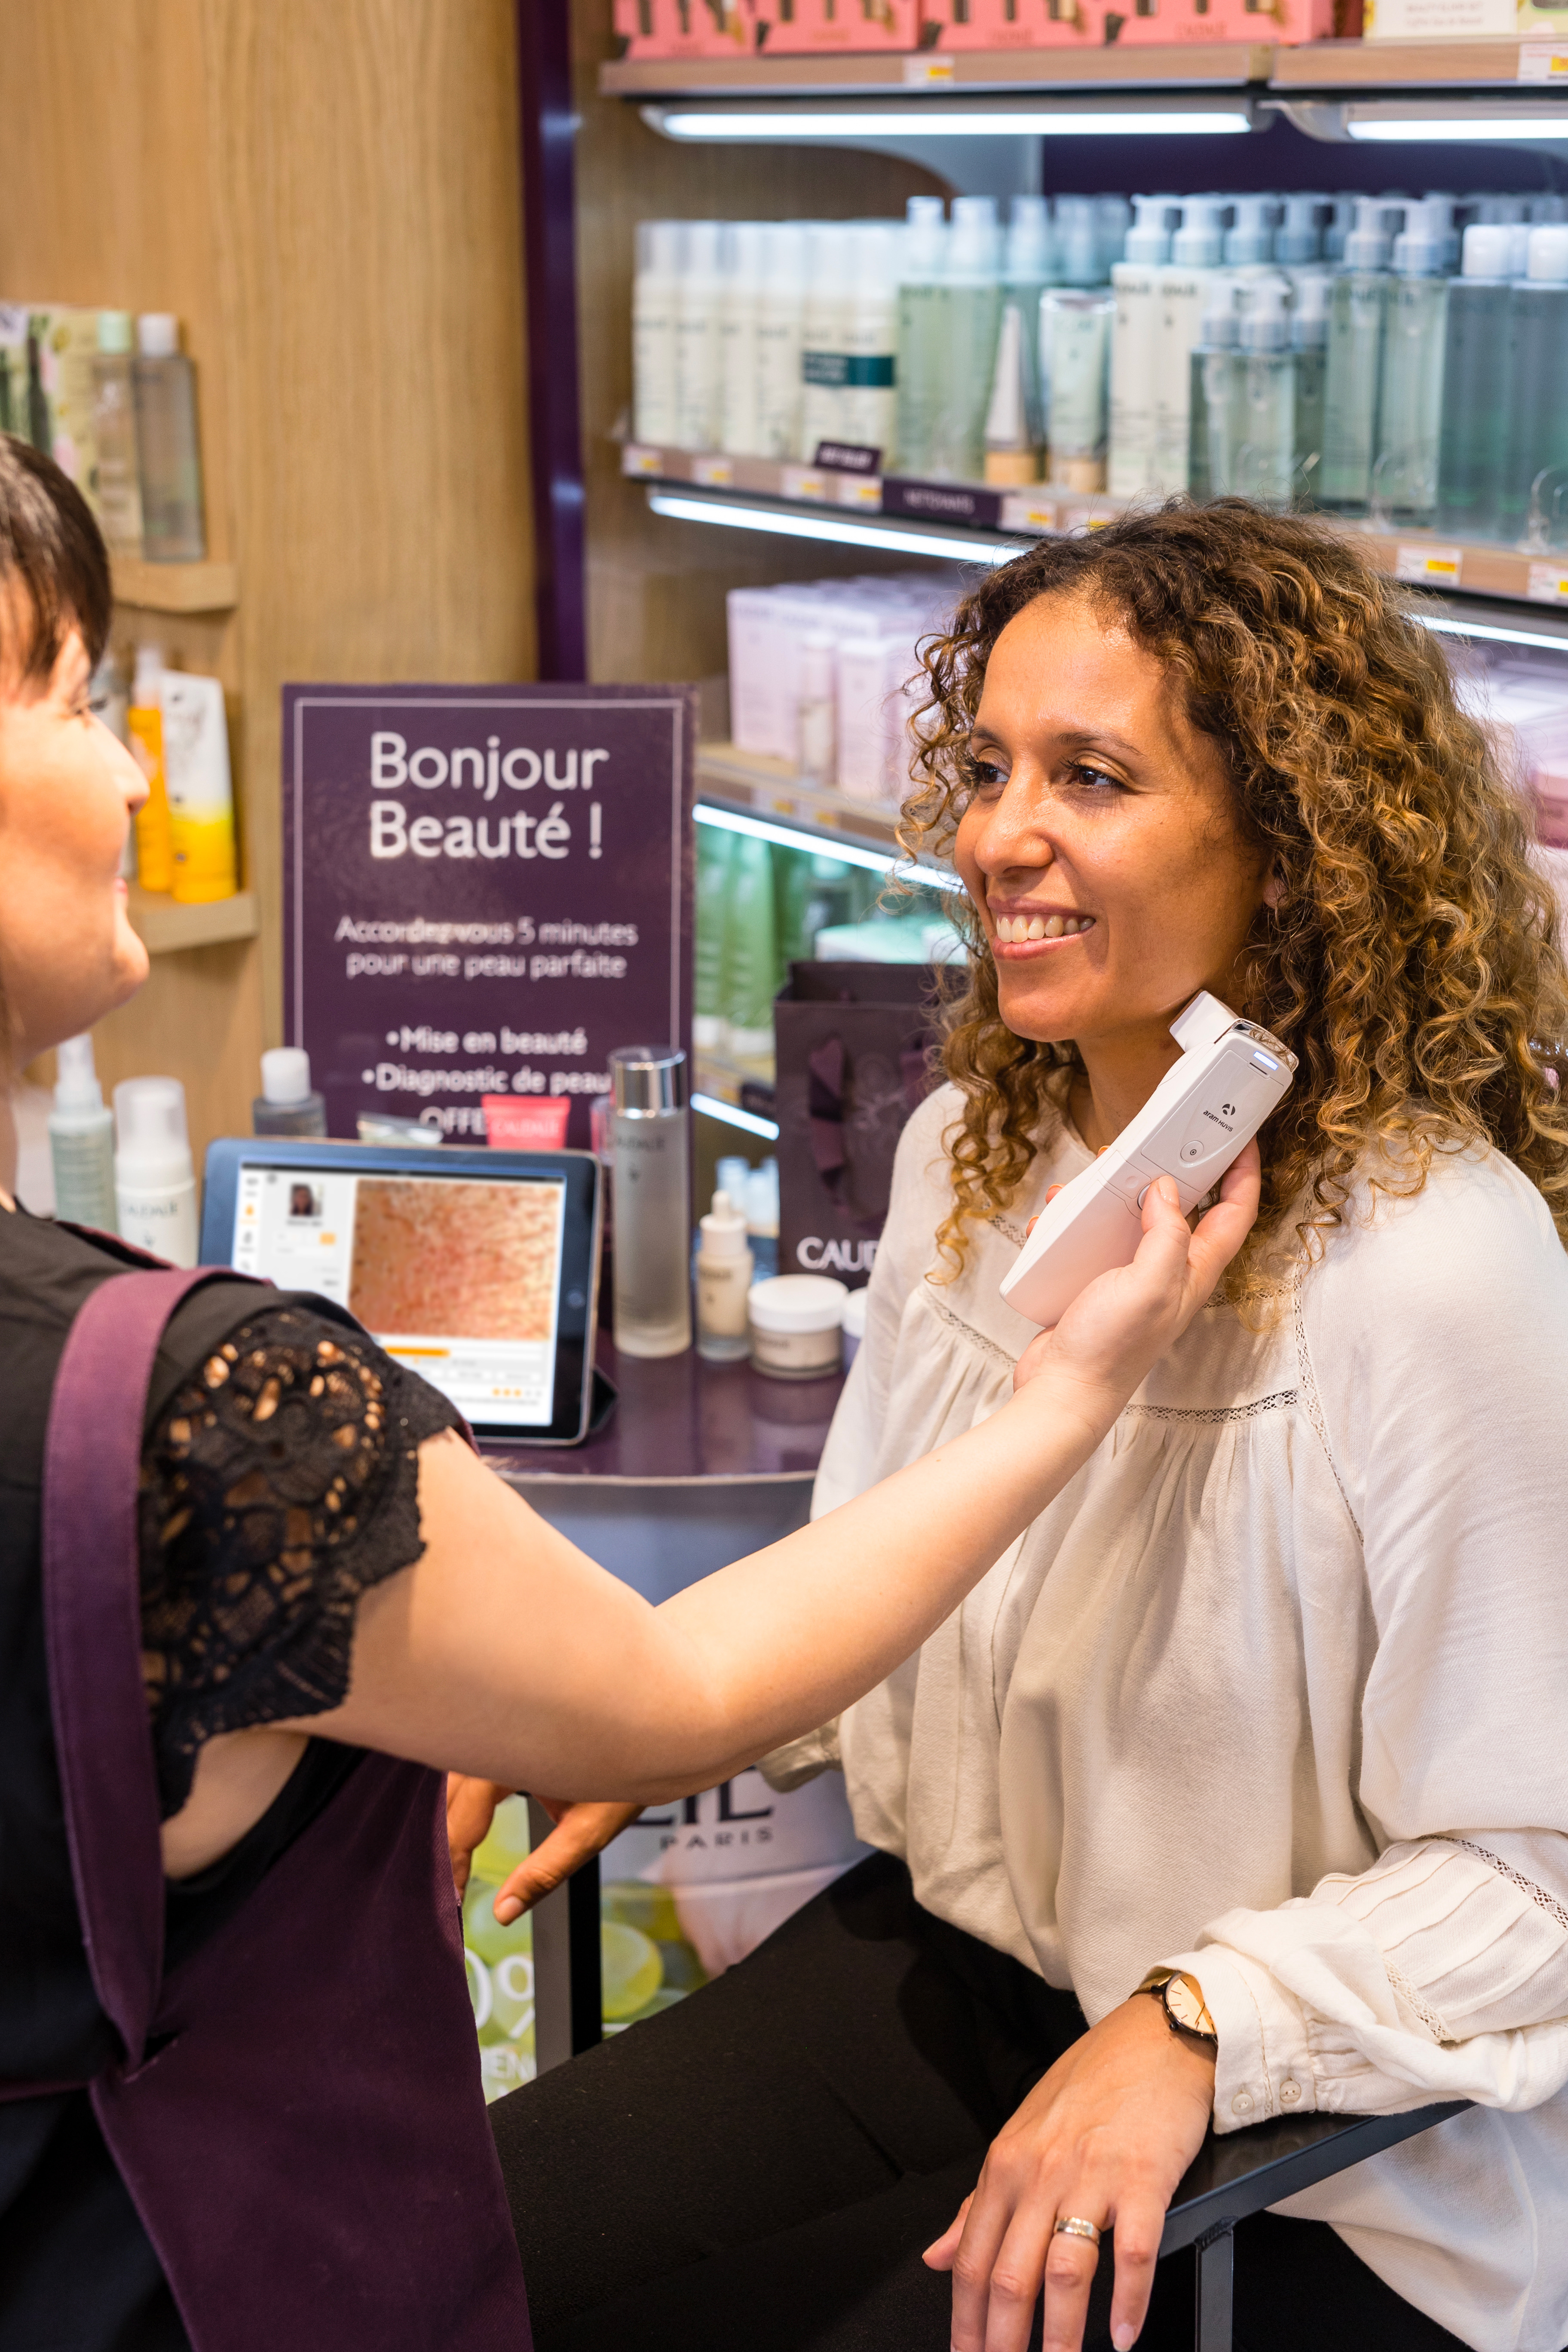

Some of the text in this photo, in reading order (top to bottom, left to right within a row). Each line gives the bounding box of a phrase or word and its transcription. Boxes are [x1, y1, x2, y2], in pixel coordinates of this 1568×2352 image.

[371, 731, 610, 801] Bonjour
[371, 799, 603, 859] Beauté !
[517, 916, 535, 945] 5
[539, 918, 638, 946] minutes
[346, 949, 627, 982] pour une peau parfaite
[462, 1032, 496, 1054] en
[500, 1026, 588, 1055] beauté
[512, 1065, 546, 1093] de
[550, 1071, 612, 1097] peau
[1203, 1110, 1234, 1132] aram HUVIS
[660, 1825, 773, 1850] PARIS
